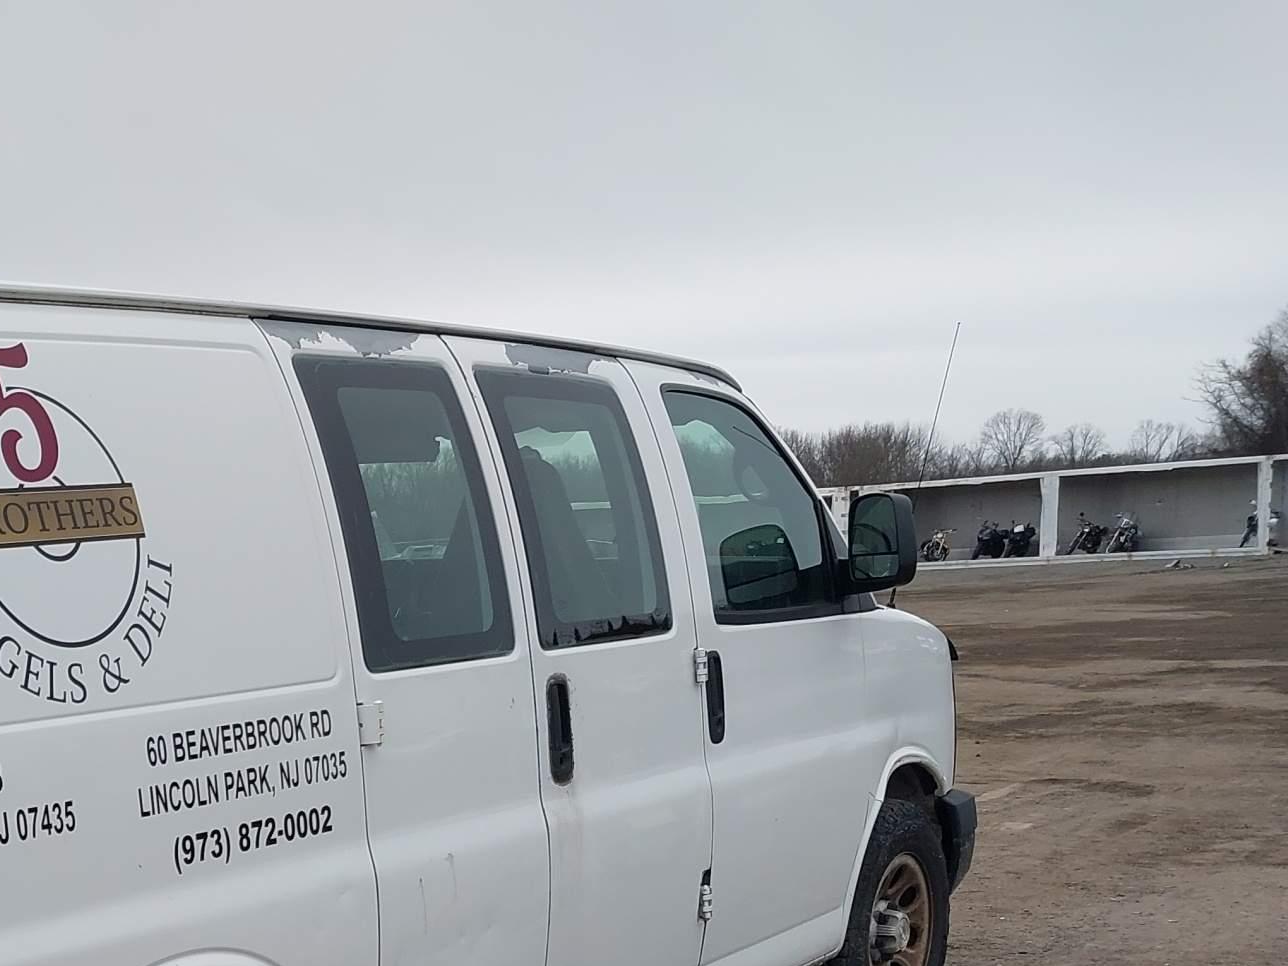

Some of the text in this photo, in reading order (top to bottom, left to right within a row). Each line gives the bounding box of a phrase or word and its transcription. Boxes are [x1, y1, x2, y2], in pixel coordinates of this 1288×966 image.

[98, 653, 130, 693] &
[123, 554, 173, 667] DELI
[146, 709, 332, 767] 60 BEAVERBROOK RD
[138, 750, 347, 818] LINCOLN PARK, NJ 07035
[16, 800, 76, 841] 07435
[174, 805, 333, 875] (973) 872-0002
